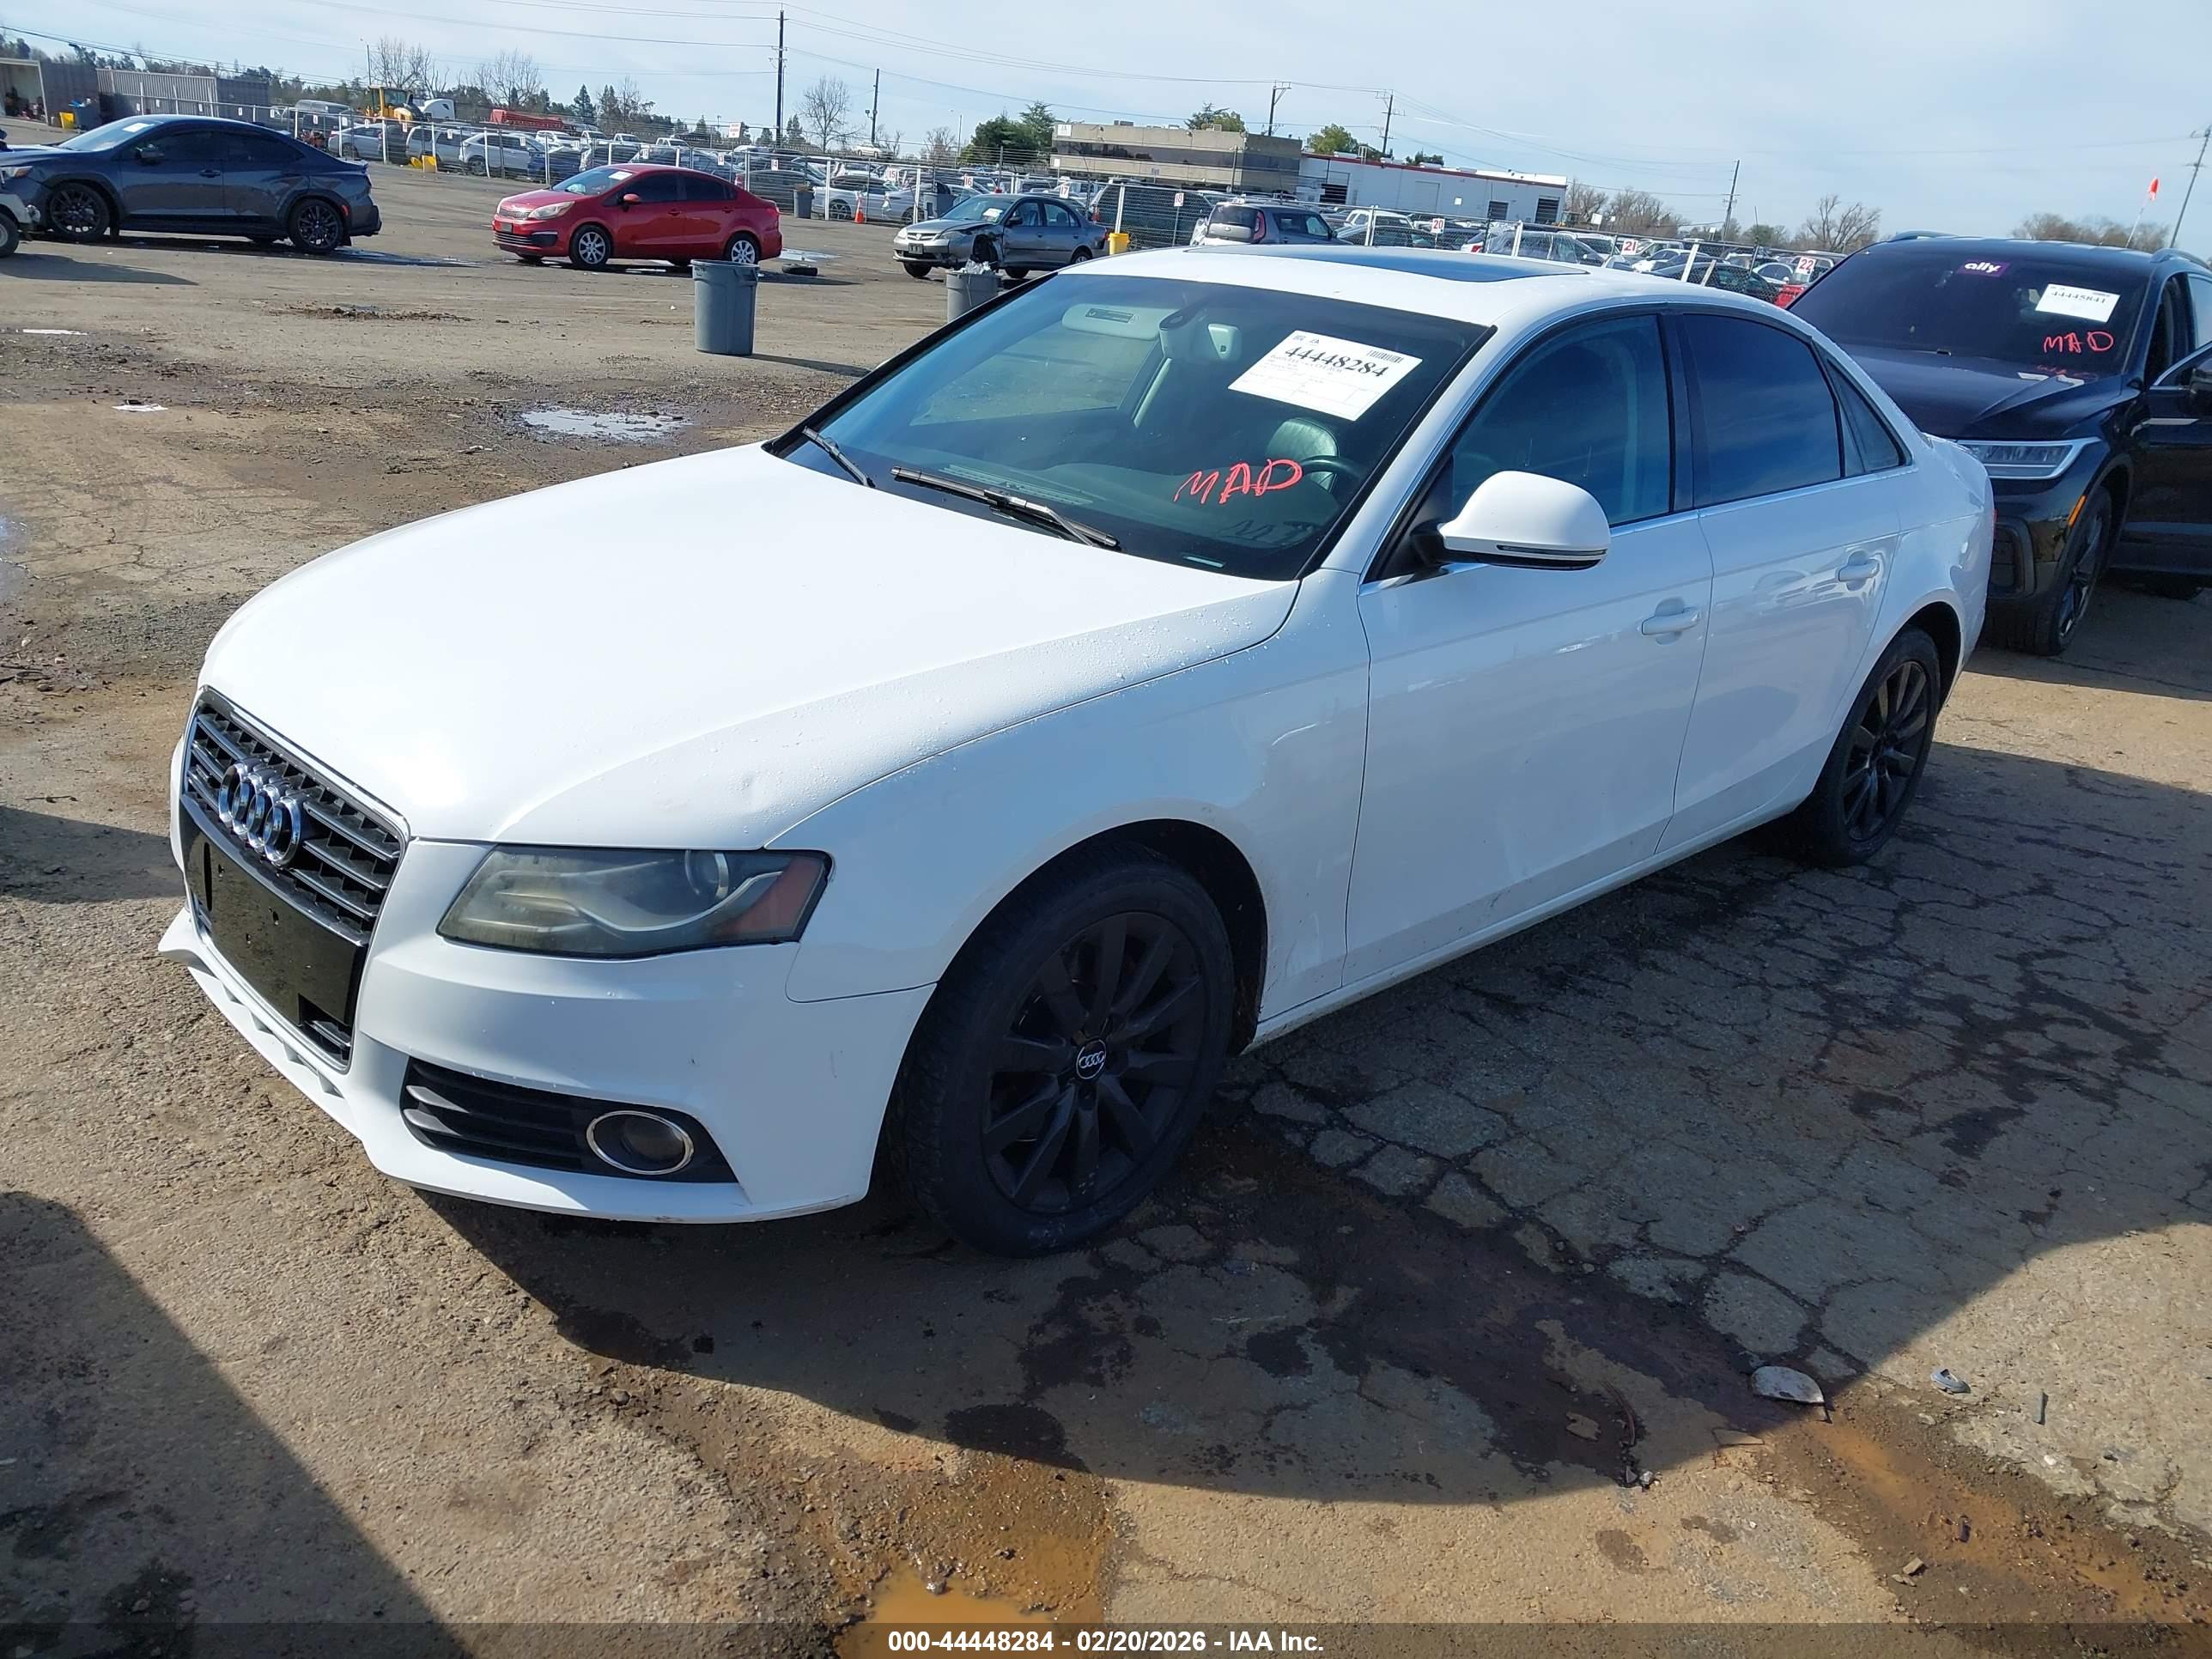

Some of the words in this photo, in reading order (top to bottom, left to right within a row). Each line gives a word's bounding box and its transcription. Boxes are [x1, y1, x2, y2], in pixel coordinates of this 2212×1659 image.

[964, 176, 972, 185] 16
[1060, 185, 1069, 195] 17
[1433, 219, 1443, 229] 20
[1623, 240, 1637, 252] 21
[1799, 258, 1814, 270] 22
[1964, 262, 2002, 273] ally
[2043, 331, 2114, 353] MAD
[1285, 346, 1389, 377] 44448284
[1173, 459, 1303, 505] MAD
